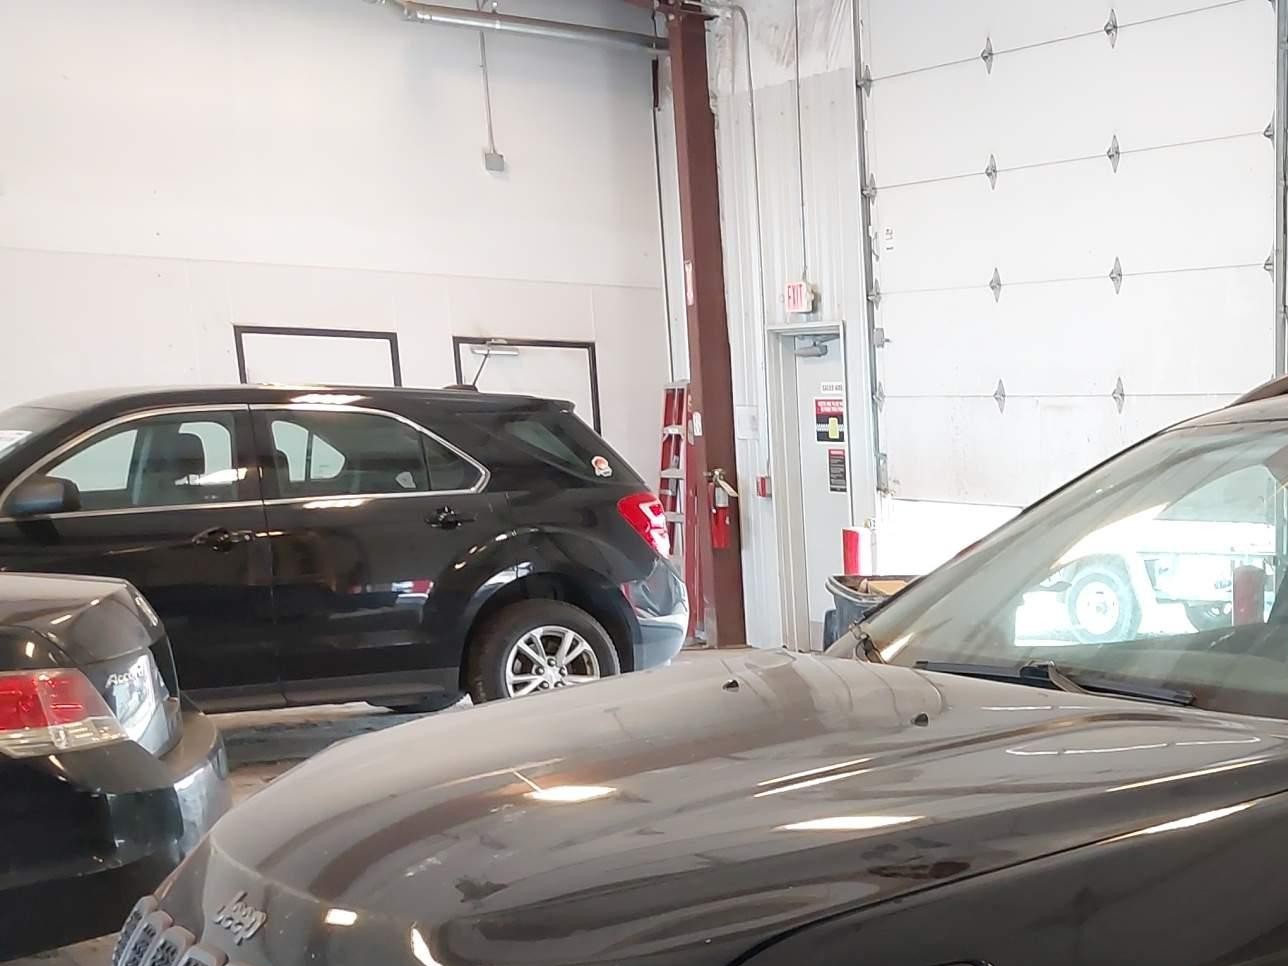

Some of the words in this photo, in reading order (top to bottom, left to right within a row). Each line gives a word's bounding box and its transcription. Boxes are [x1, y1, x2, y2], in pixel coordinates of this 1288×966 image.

[787, 283, 804, 309] EXIT
[105, 664, 145, 689] Accord
[214, 891, 268, 946] Jeep
